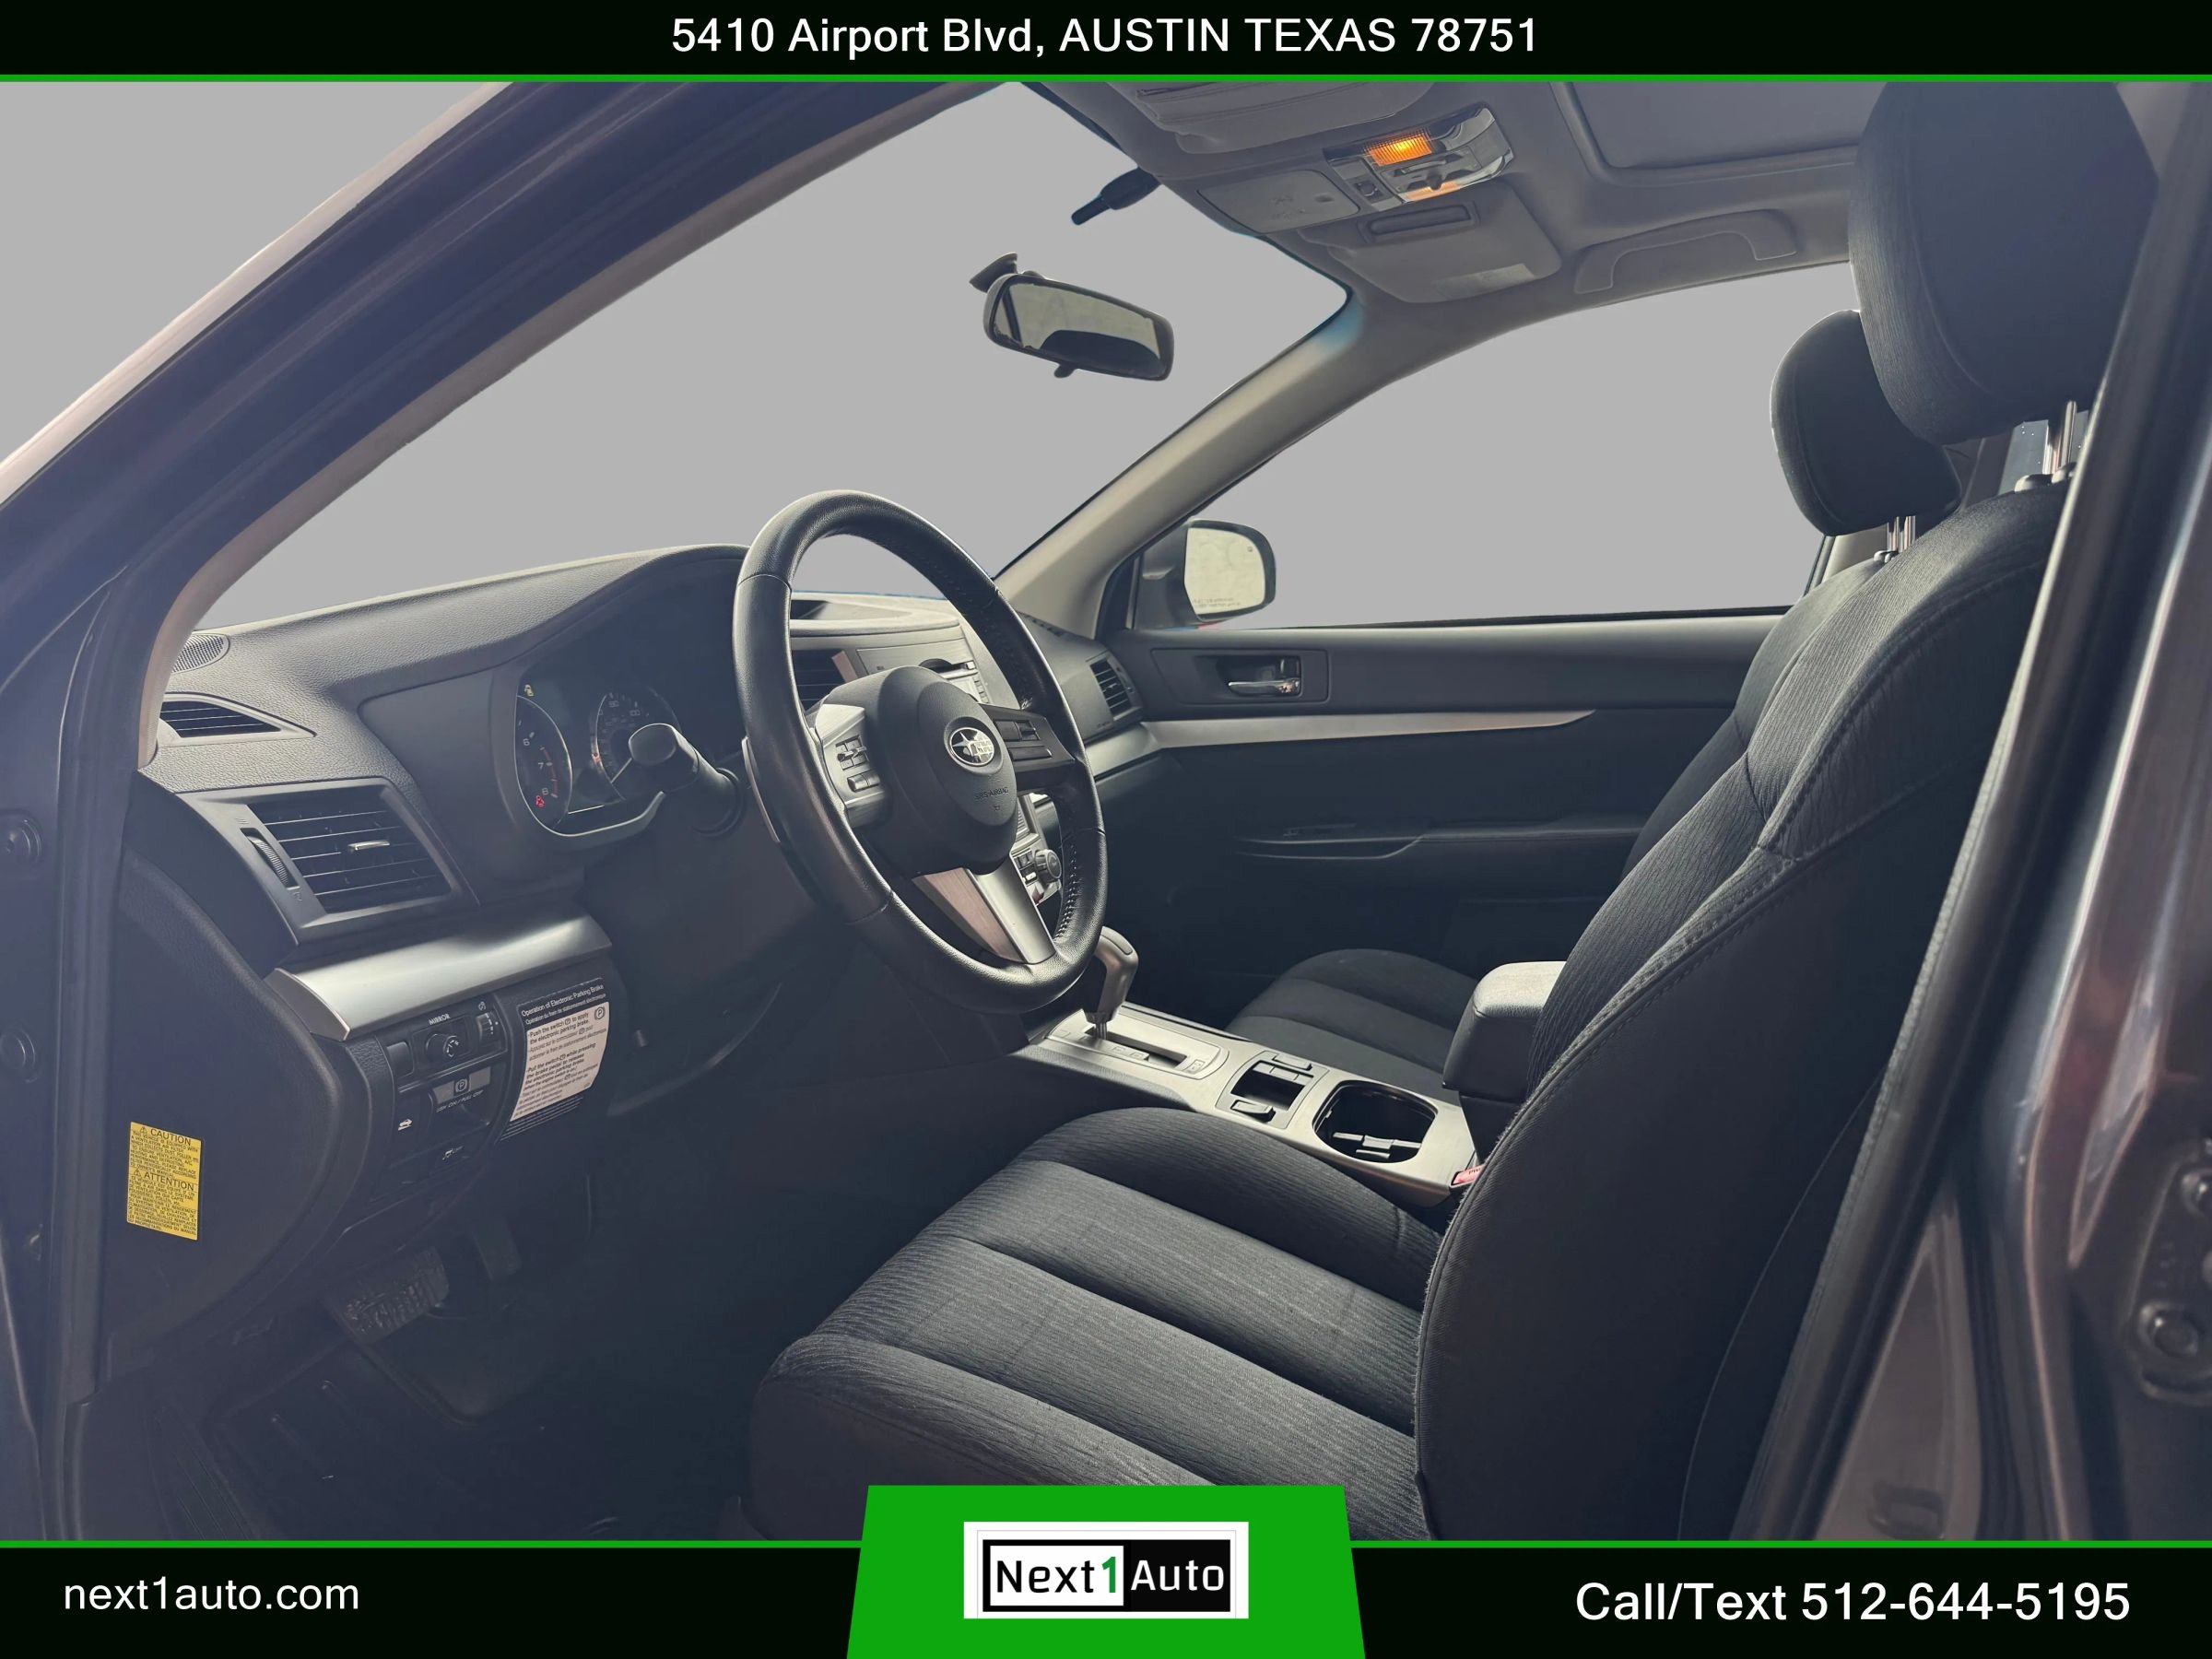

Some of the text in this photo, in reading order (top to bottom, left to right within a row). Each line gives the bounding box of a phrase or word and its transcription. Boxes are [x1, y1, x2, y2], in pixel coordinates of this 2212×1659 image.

[523, 737, 530, 747] 6
[537, 762, 545, 771] 7
[521, 1005, 546, 1018] Operation
[550, 994, 573, 1007] Electronic
[573, 989, 591, 1000] Parking
[591, 984, 604, 993] Brake
[429, 1014, 450, 1026] MIRROR
[150, 1128, 191, 1146] CAUTION
[144, 1171, 194, 1191] ATTENTION
